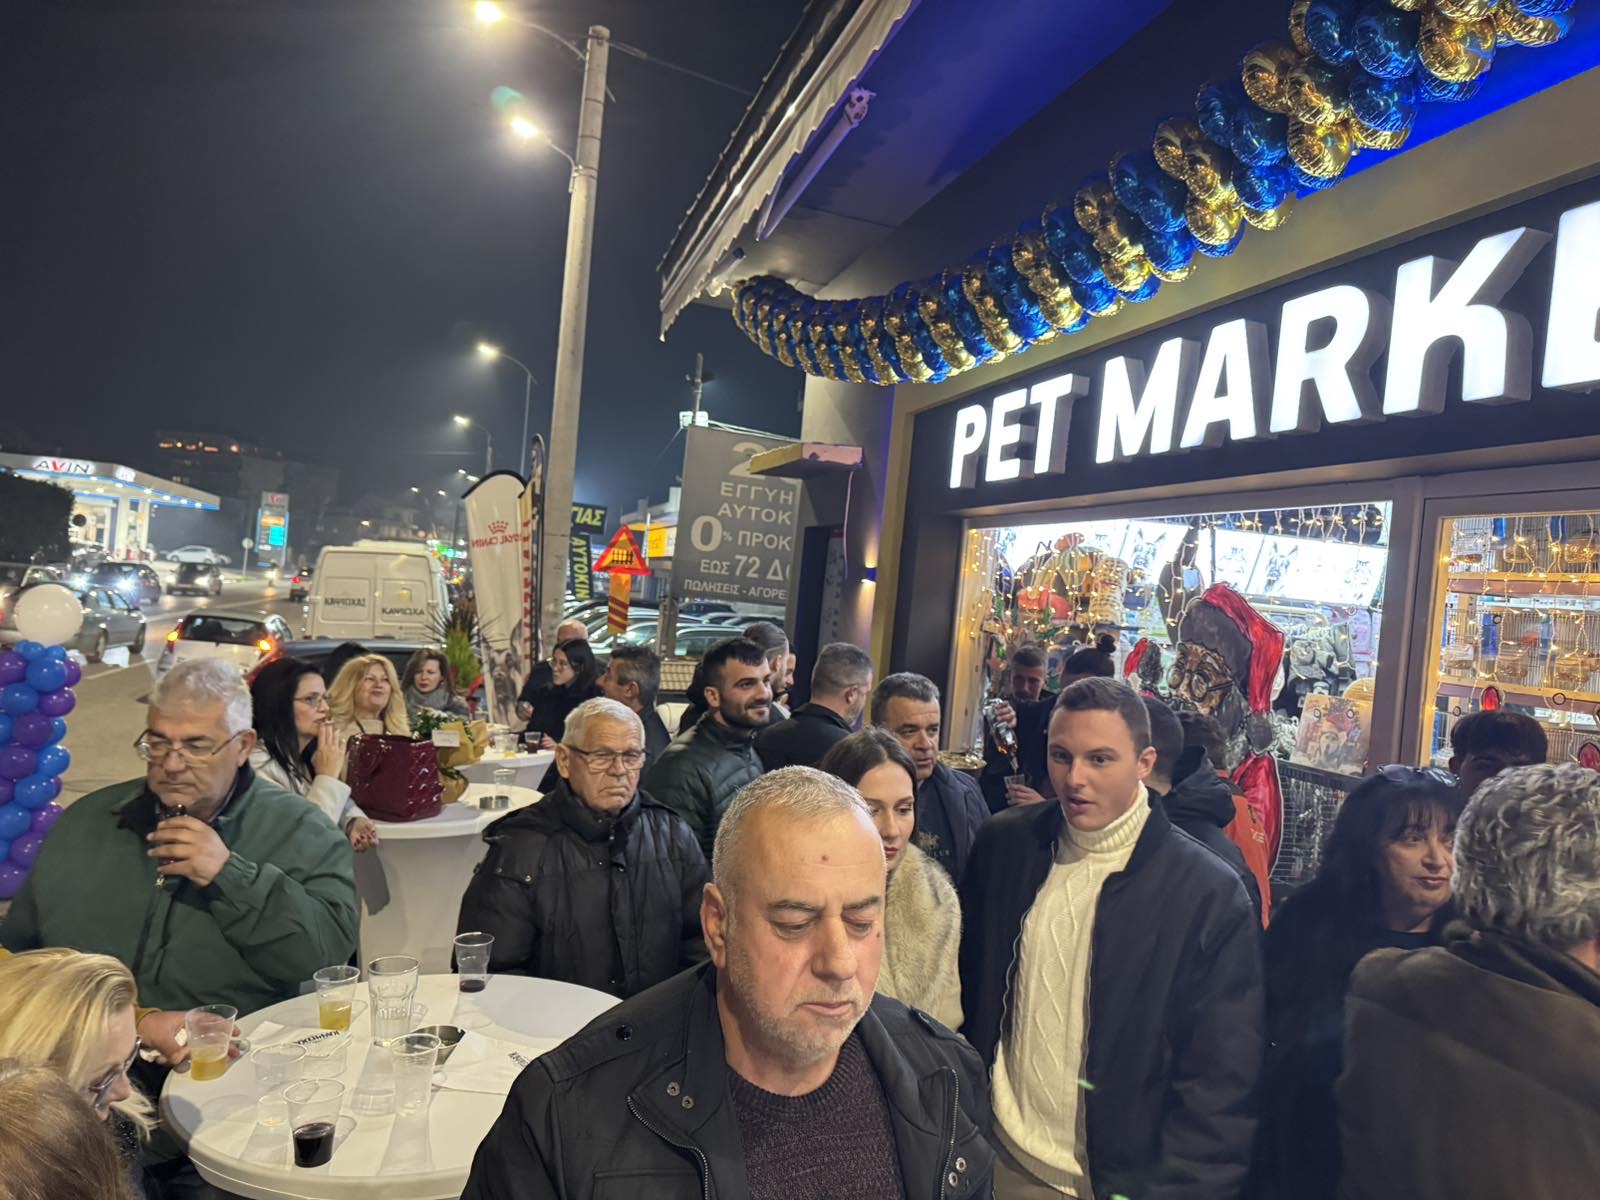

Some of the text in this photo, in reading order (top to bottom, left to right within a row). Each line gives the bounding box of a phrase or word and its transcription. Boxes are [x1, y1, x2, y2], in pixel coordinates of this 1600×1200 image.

[949, 373, 1075, 489] PET
[35, 460, 90, 473] AVIN
[720, 482, 793, 505] ΕΓΓΥΗ
[717, 502, 792, 525] ΑΥΤΟΚ
[738, 530, 792, 551] ΠΡΟΚ
[700, 555, 791, 580] ΕΩΣ 72 Δ
[683, 579, 740, 595] ΠΩΛΗΣΕΙΣ
